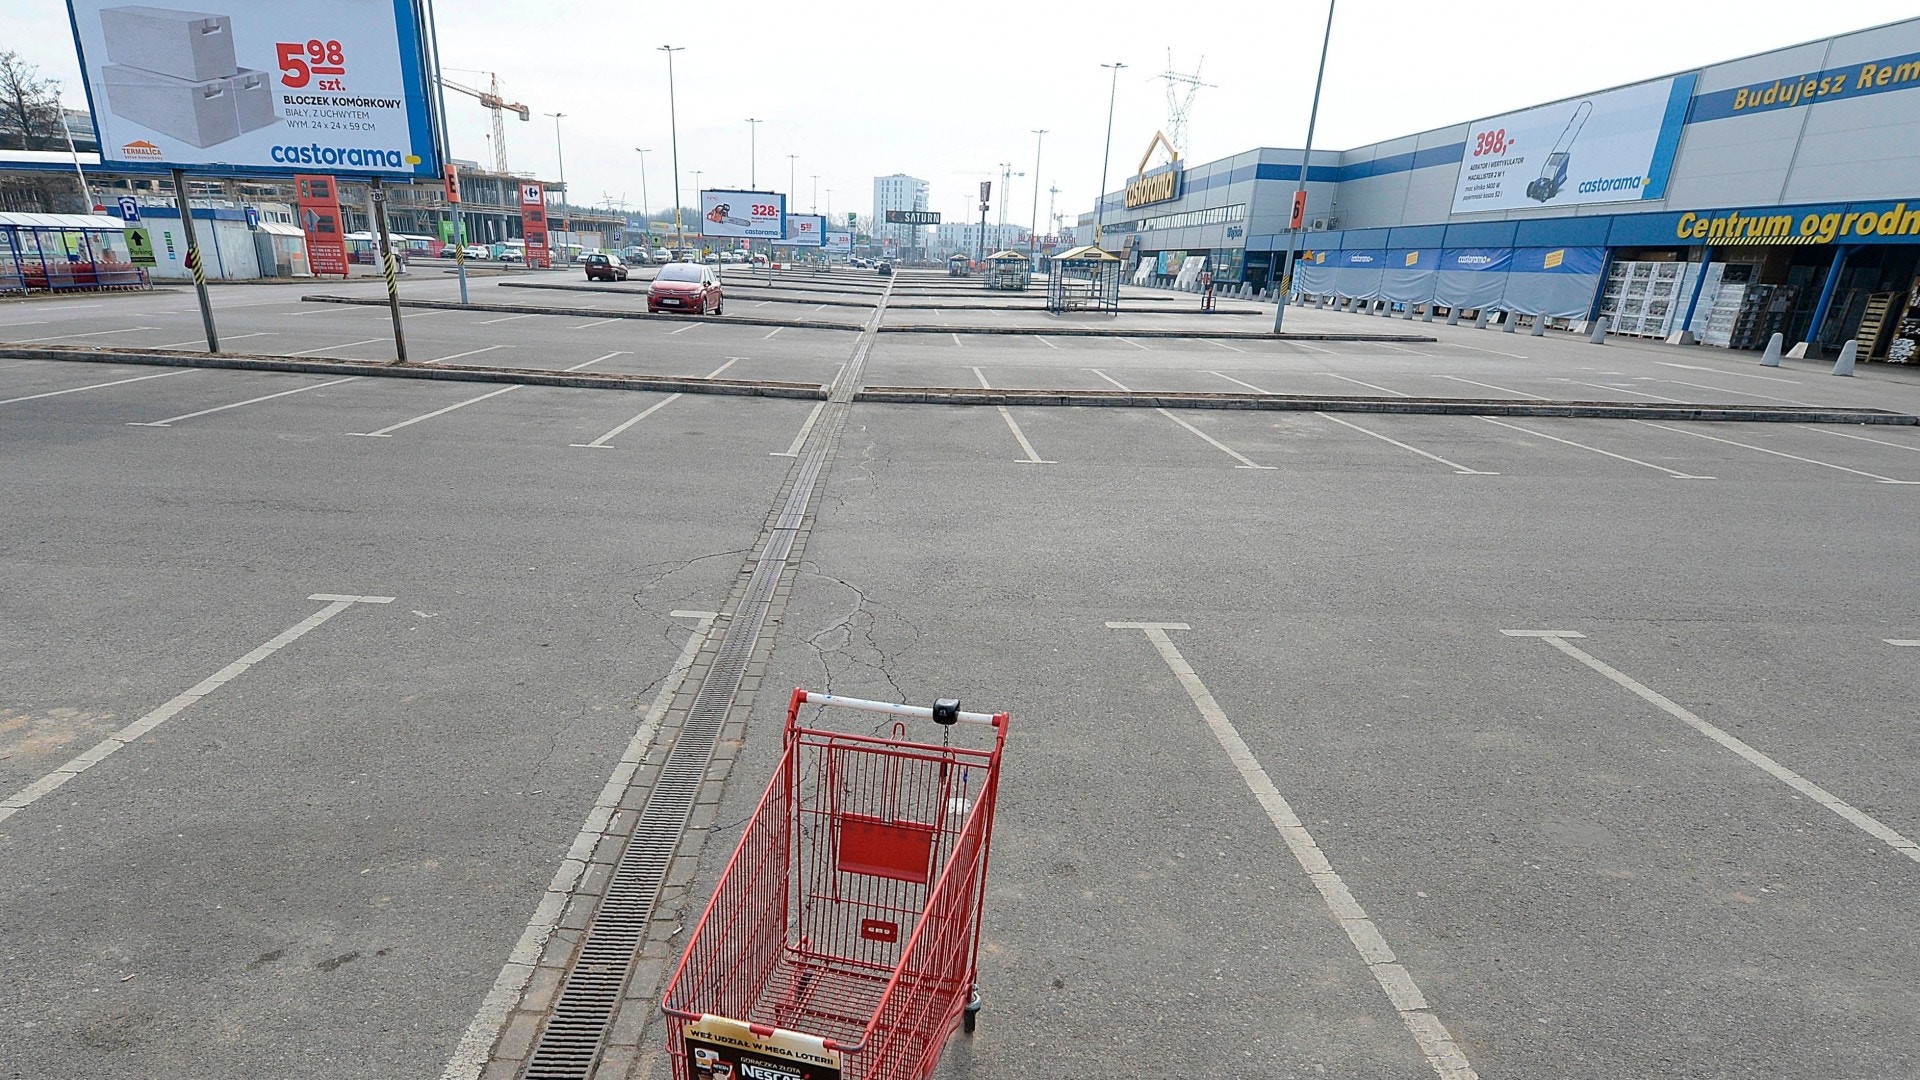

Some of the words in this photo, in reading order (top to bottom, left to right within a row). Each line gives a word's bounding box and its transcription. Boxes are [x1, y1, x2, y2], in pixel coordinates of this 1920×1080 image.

[318, 78, 346, 92] szt.
[1732, 73, 1848, 111] Budujesz
[1856, 60, 1920, 90] Rem
[283, 95, 330, 106] BLOCZEK
[331, 96, 401, 109] KOMÓRKOWY
[285, 108, 312, 118] BIAŁY,
[313, 109, 318, 117] Z
[320, 110, 370, 120] UCHWYTEM
[286, 120, 309, 129] WYM.
[311, 121, 322, 129] 24
[330, 122, 341, 130] 24
[349, 122, 360, 131] 59
[361, 123, 376, 131] CM
[1473, 128, 1515, 157] 398,-
[121, 148, 162, 156] TERMALICA
[271, 143, 403, 167] castorama
[448, 174, 456, 193] E
[1125, 171, 1174, 209] castorama
[1578, 175, 1642, 194] castorama
[122, 202, 136, 219] P
[751, 204, 780, 217] 328,-
[904, 212, 940, 224] SATURN
[1292, 200, 1300, 219] 6
[1676, 210, 1794, 239] Centrum
[1799, 202, 1920, 244] ogrodn
[129, 247, 153, 257] Parking
[1457, 254, 1488, 264] castorama
[690, 1029, 713, 1040] WEŹ
[714, 1034, 751, 1048] UDZIAŁ
[752, 1042, 763, 1051] W
[764, 1045, 794, 1057] MEGA
[795, 1051, 834, 1066] LOTERII
